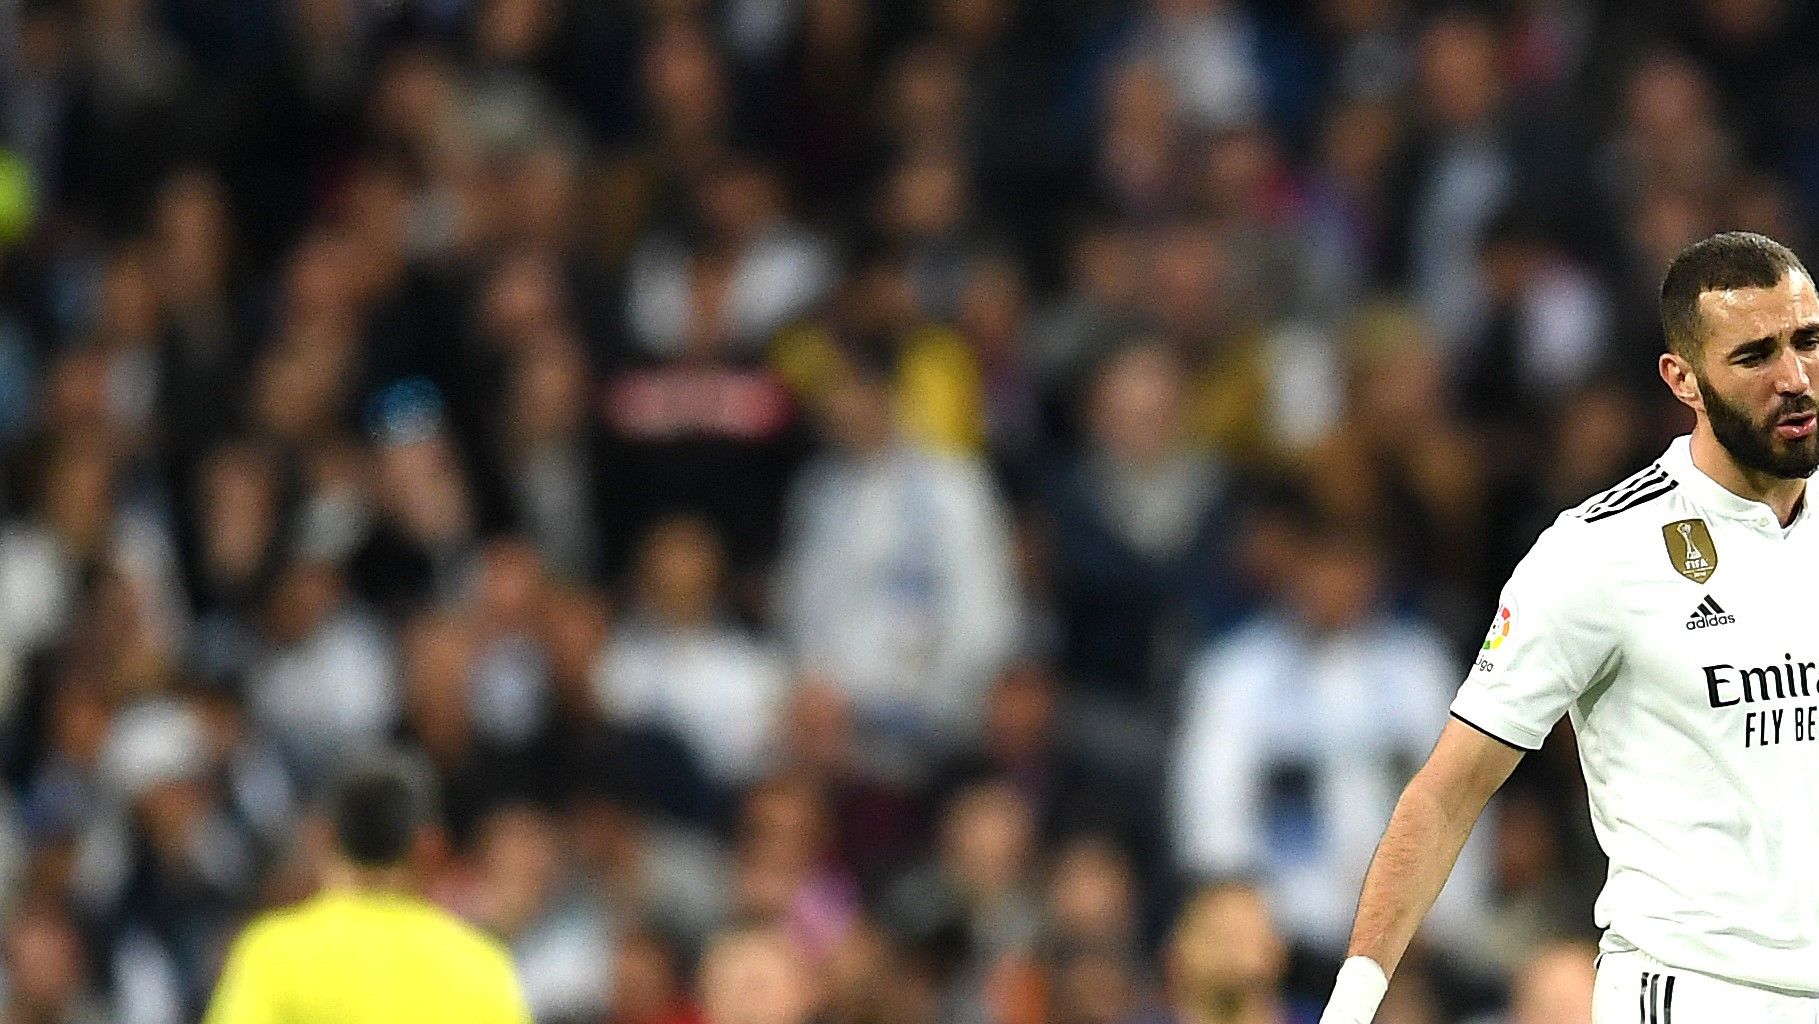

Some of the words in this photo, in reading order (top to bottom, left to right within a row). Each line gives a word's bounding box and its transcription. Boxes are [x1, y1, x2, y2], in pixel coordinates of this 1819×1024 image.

[1685, 558, 1709, 570] FIFA
[1686, 613, 1736, 630] adidas
[1745, 709, 1784, 748] FLY
